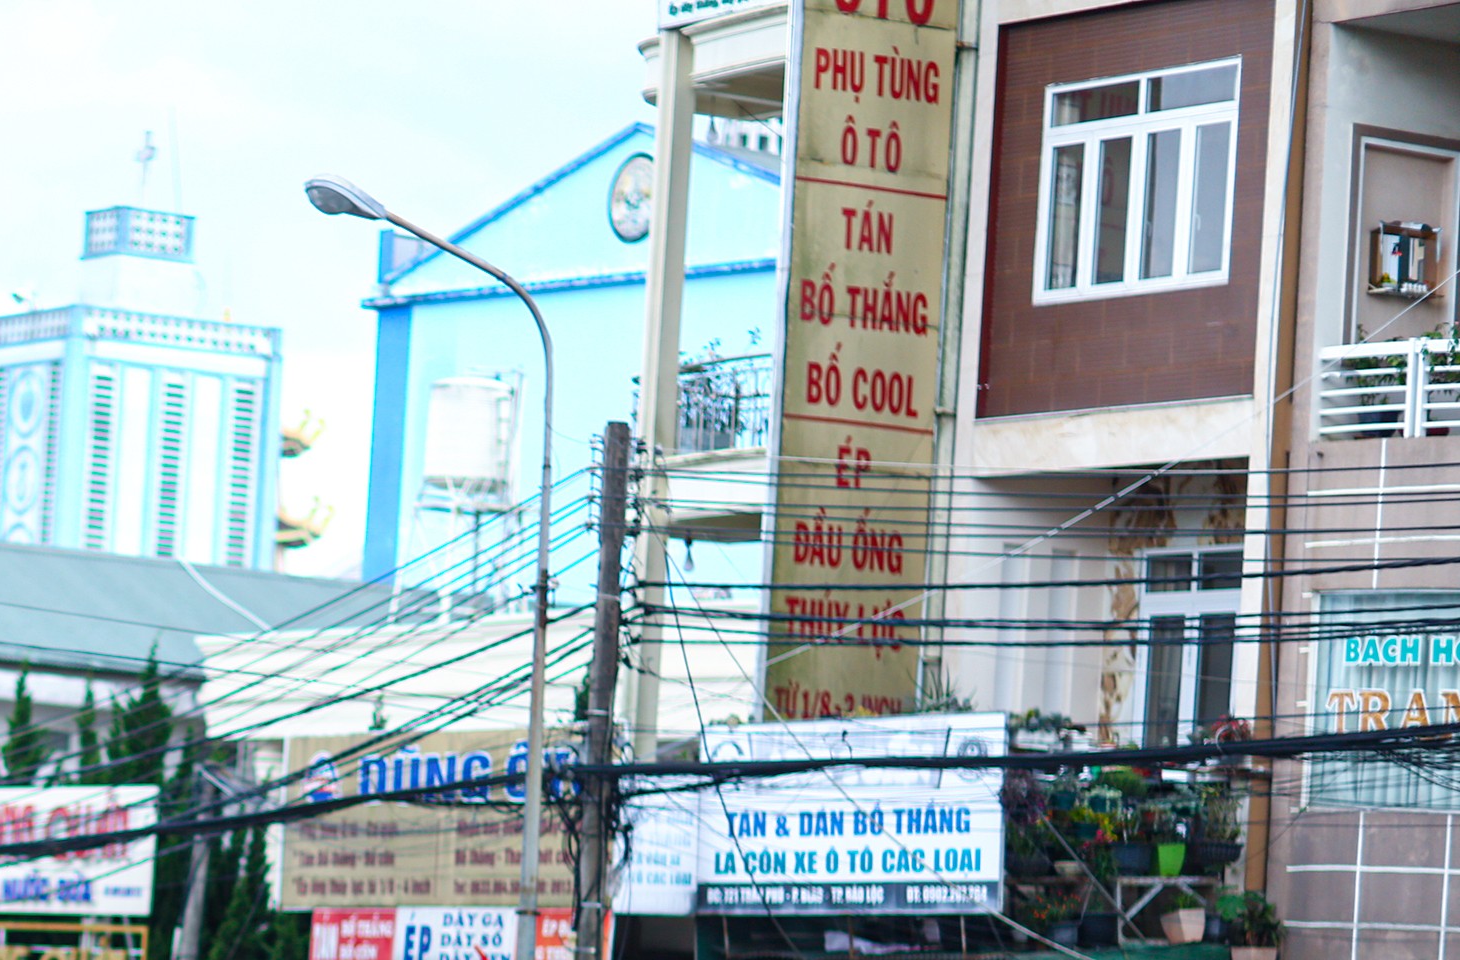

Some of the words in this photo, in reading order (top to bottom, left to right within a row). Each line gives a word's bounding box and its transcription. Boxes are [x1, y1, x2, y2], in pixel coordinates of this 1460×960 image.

[814, 47, 866, 103] PHỤ
[874, 46, 940, 105] TÙNG
[842, 200, 894, 254] TÁN
[799, 262, 836, 326] BỐ
[846, 271, 928, 337] THẮNG
[806, 342, 842, 406] BỐ
[852, 367, 918, 418] COOL
[836, 435, 871, 488] ÉP
[852, 507, 903, 576] ỐNG
[1431, 635, 1460, 665] H
[794, 850, 817, 874] XE
[847, 845, 873, 873] TÔ
[934, 848, 981, 877] LOẠI
[442, 911, 478, 927] DÂY
